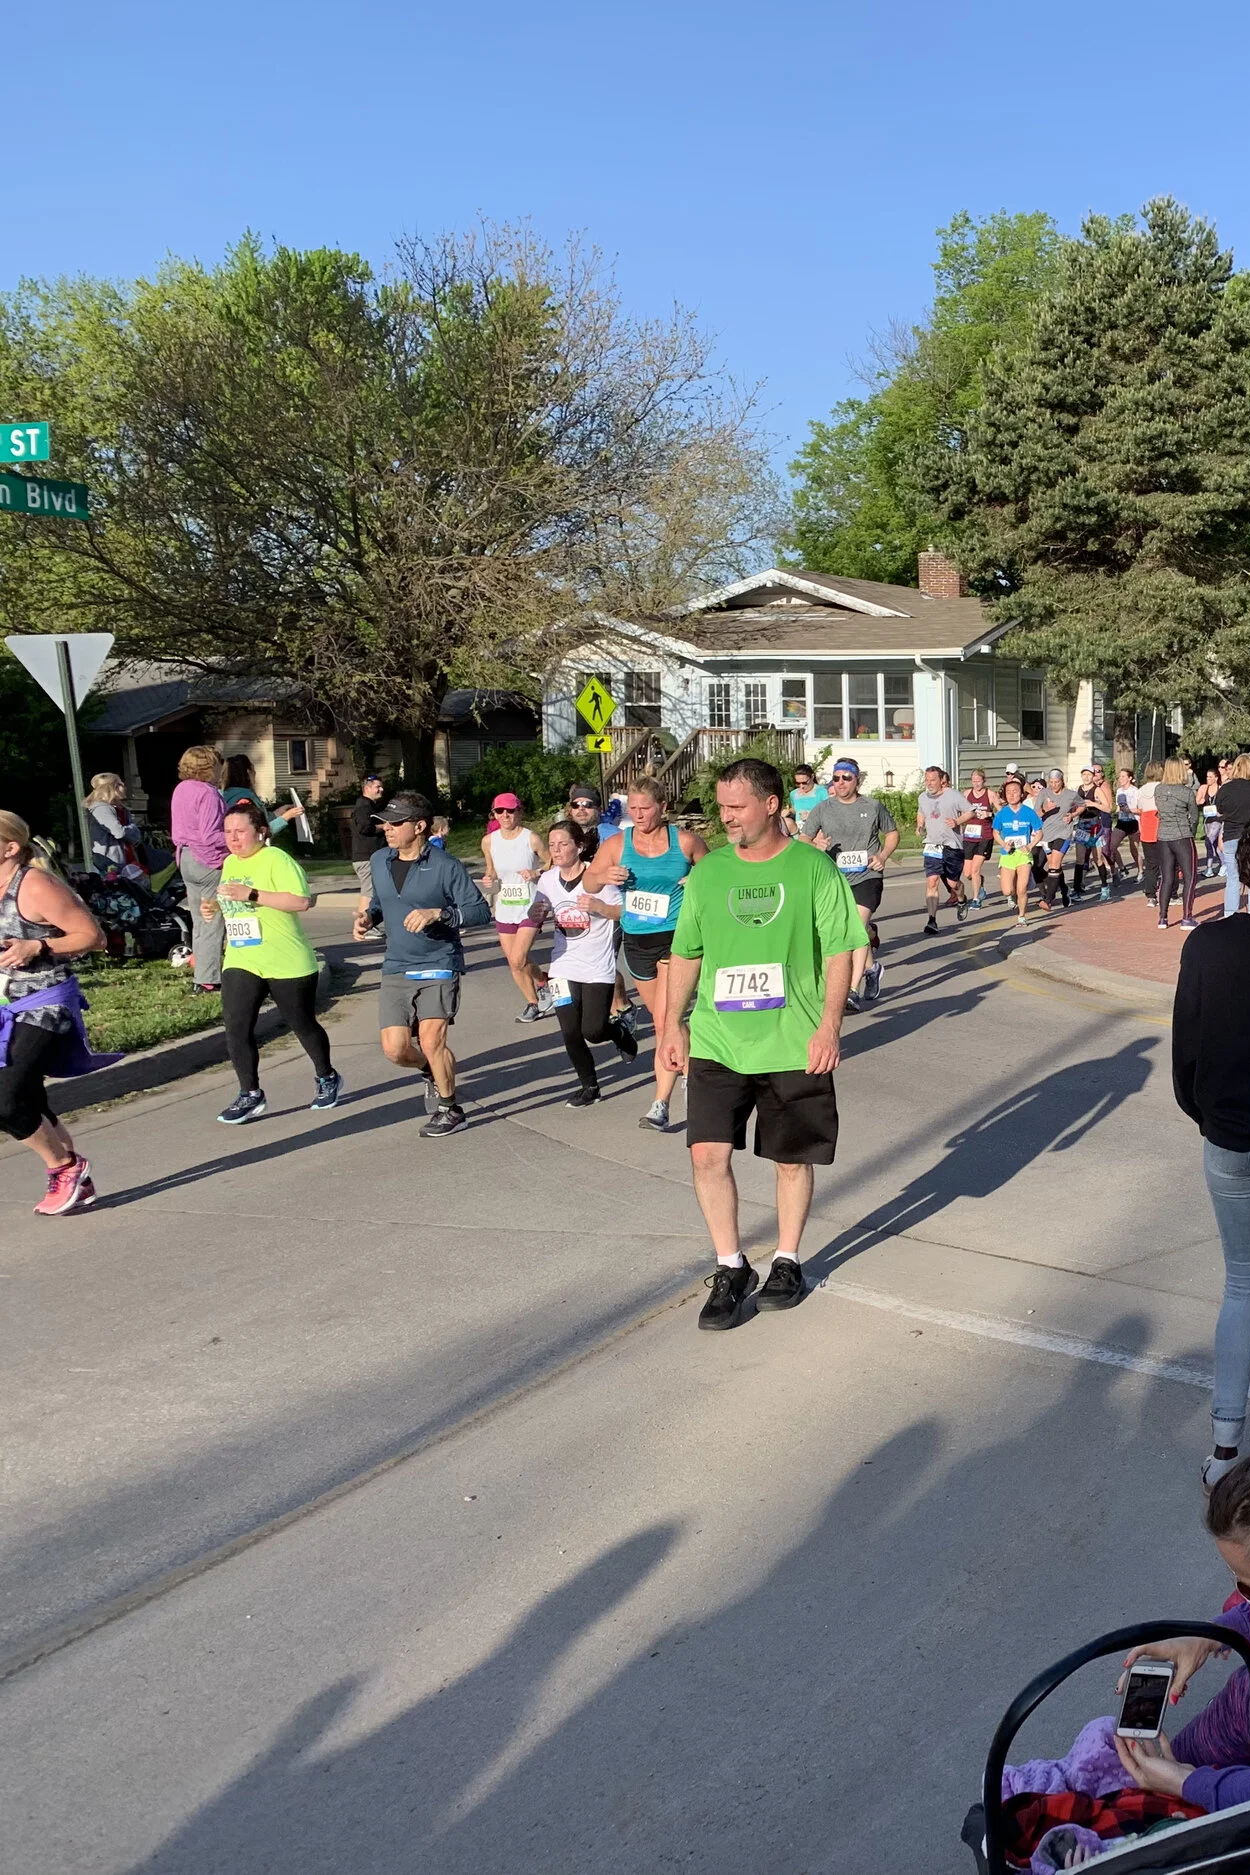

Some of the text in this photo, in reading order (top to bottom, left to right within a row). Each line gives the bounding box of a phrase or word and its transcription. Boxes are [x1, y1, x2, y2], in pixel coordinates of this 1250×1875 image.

[10, 428, 40, 457] ST
[26, 481, 77, 513] Blvd
[841, 854, 862, 865] 3324
[502, 887, 523, 898] 3003
[738, 886, 776, 900] LINCOLN
[631, 896, 659, 912] 4661
[227, 923, 251, 936] 3603
[727, 972, 770, 994] 7742
